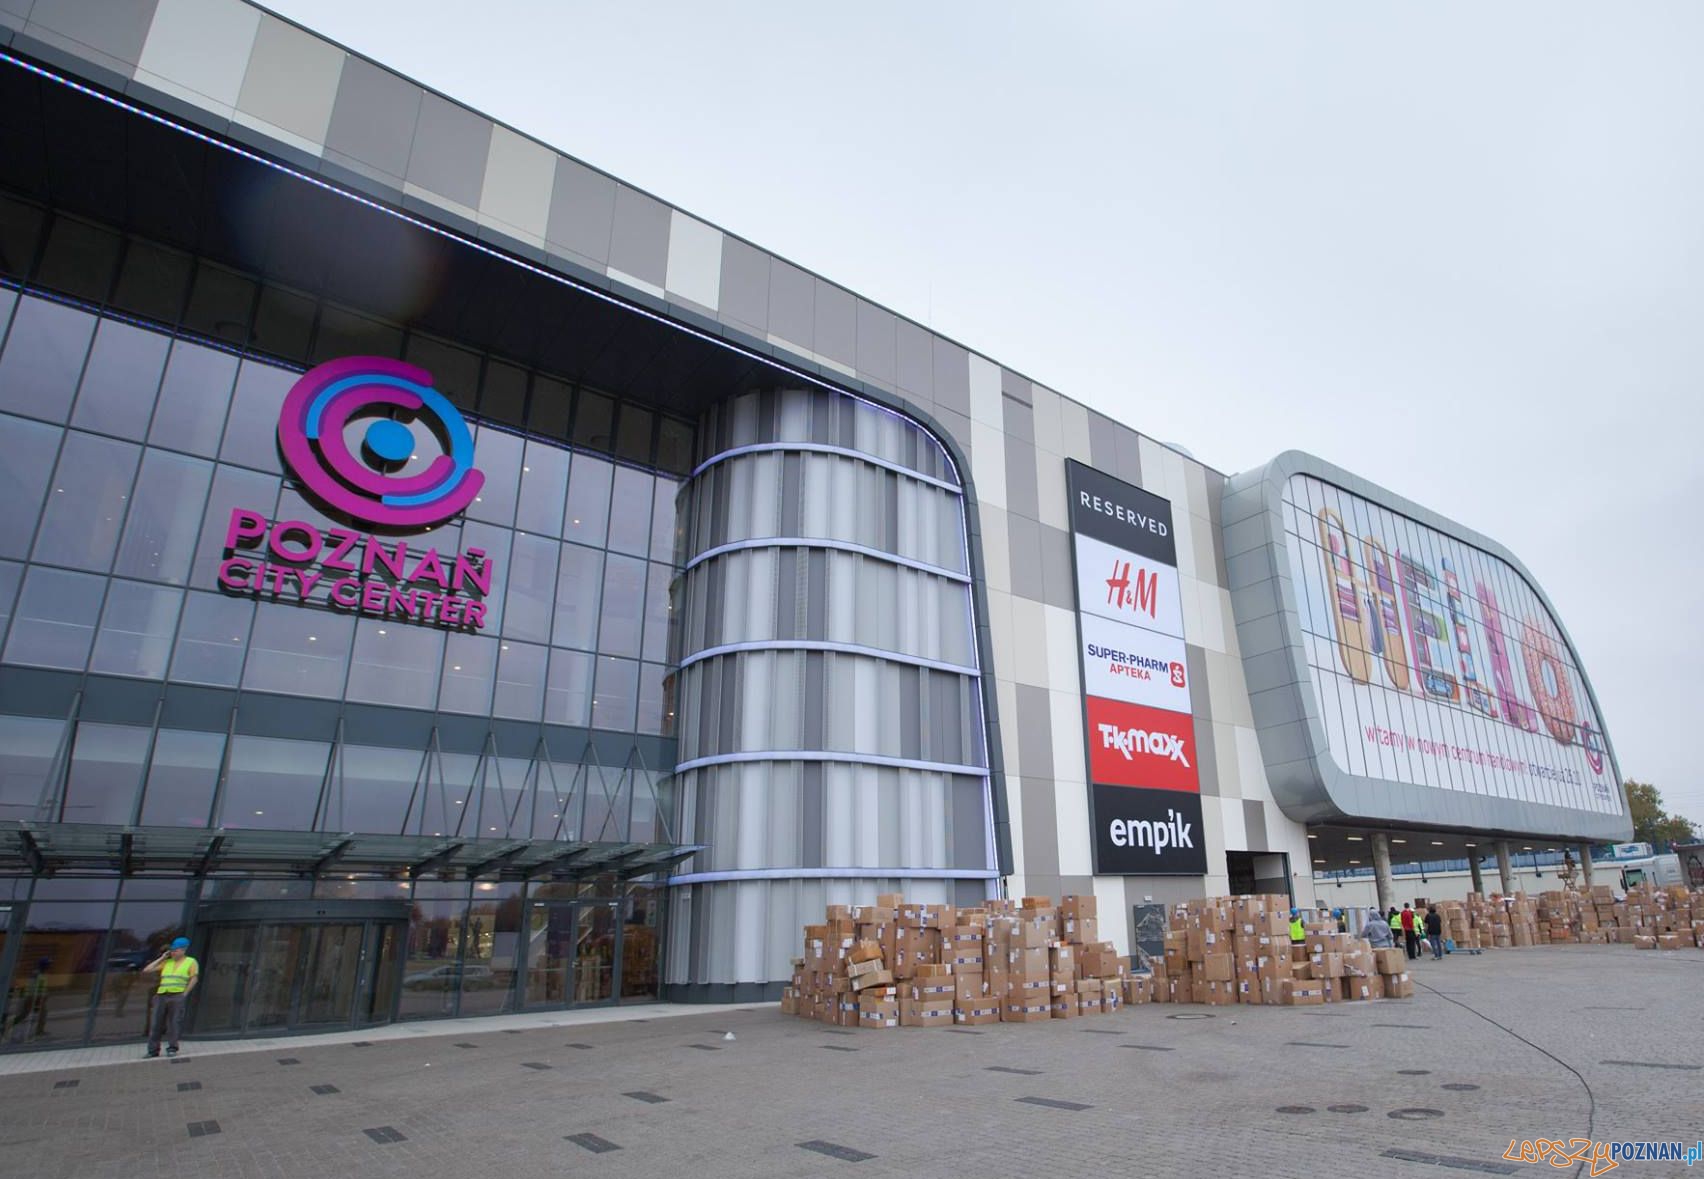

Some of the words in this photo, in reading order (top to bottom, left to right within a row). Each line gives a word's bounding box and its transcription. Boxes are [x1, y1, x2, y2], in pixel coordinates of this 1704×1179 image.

[1080, 490, 1168, 537] RESERVED
[224, 507, 493, 597] POZNAŃ
[219, 557, 324, 599] CITY
[331, 578, 488, 629] CENTER
[1106, 559, 1159, 619] H&M
[1088, 644, 1169, 674] SUPER-PHARM
[1109, 663, 1151, 681] APTEKA
[1110, 808, 1194, 855] empik
